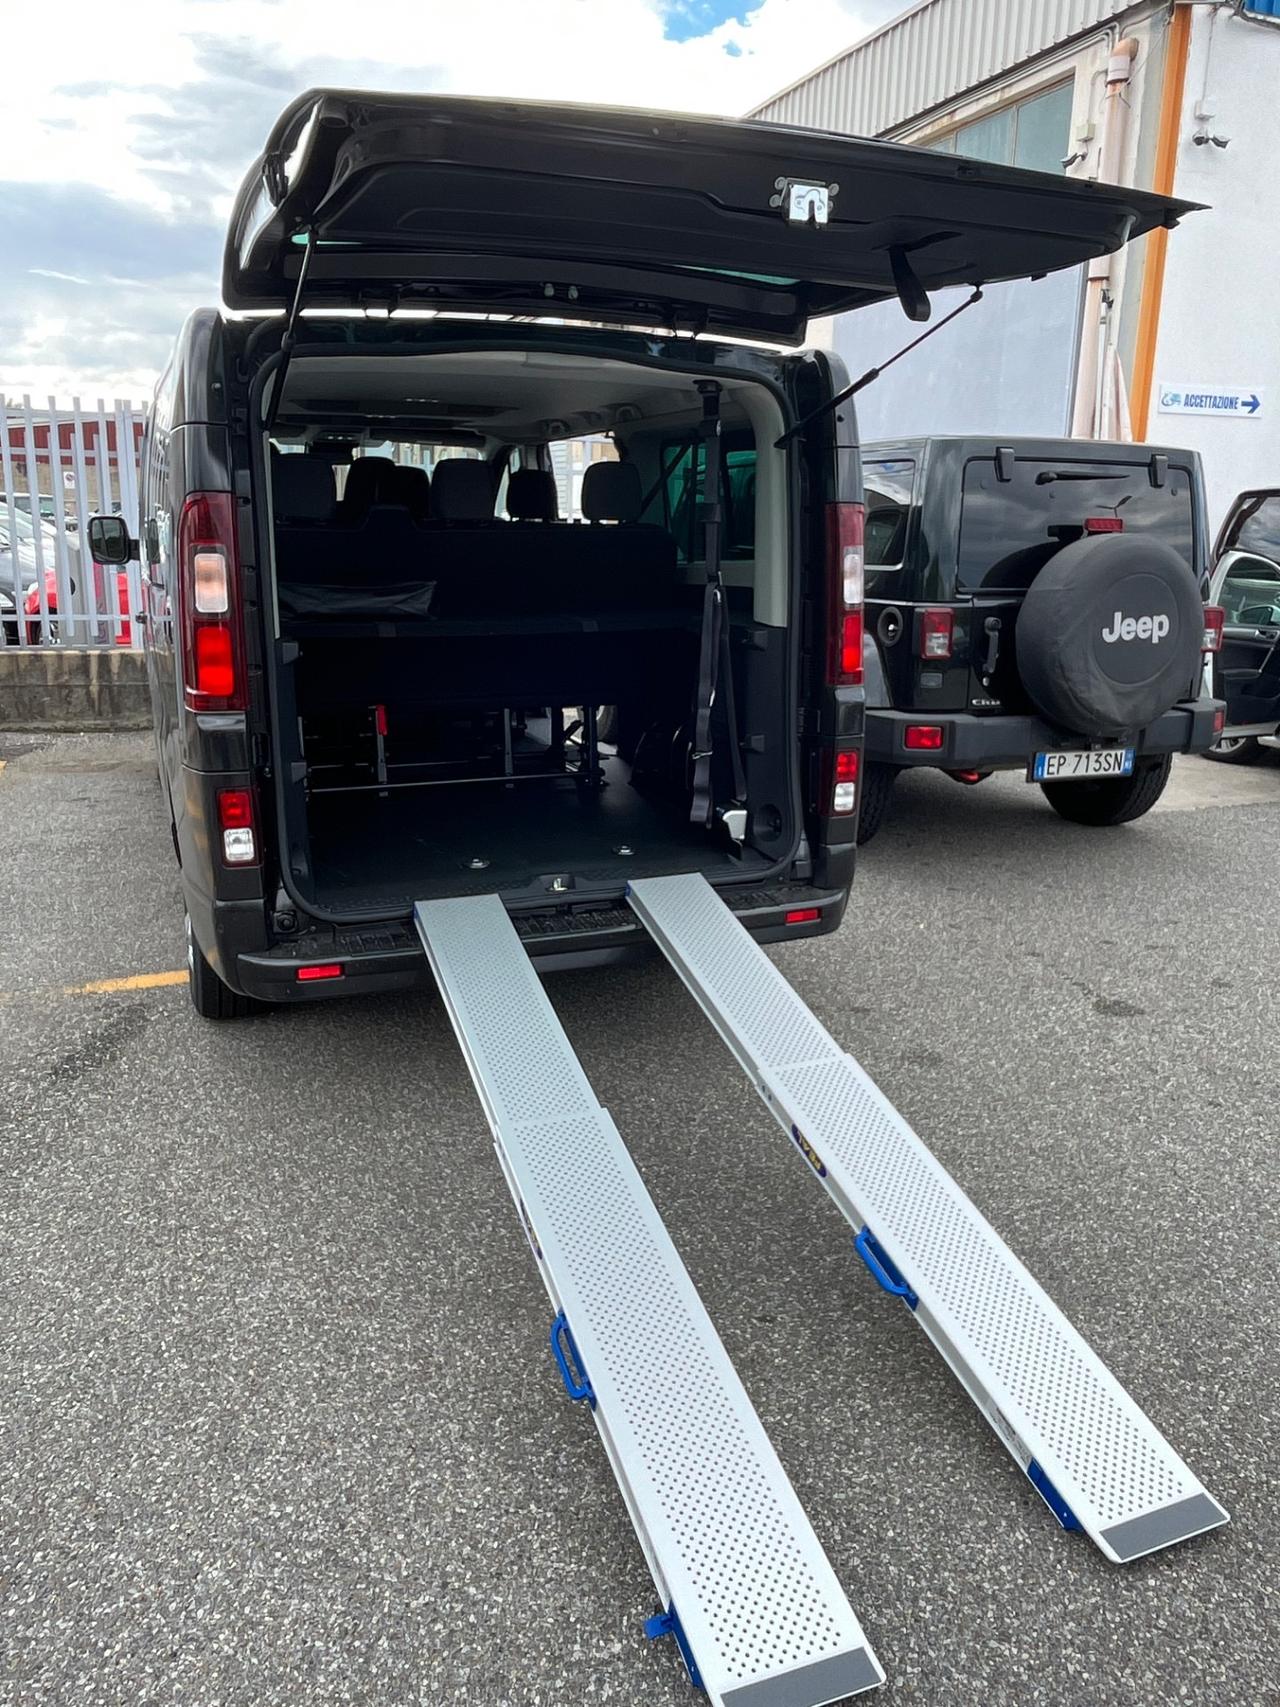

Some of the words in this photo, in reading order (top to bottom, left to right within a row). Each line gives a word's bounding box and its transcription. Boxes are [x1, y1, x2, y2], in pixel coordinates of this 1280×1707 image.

[1183, 393, 1239, 410] ACCETTAZIONE
[1102, 611, 1169, 644] Jeep
[1046, 755, 1067, 776] EP
[1072, 751, 1124, 774] 713SN
